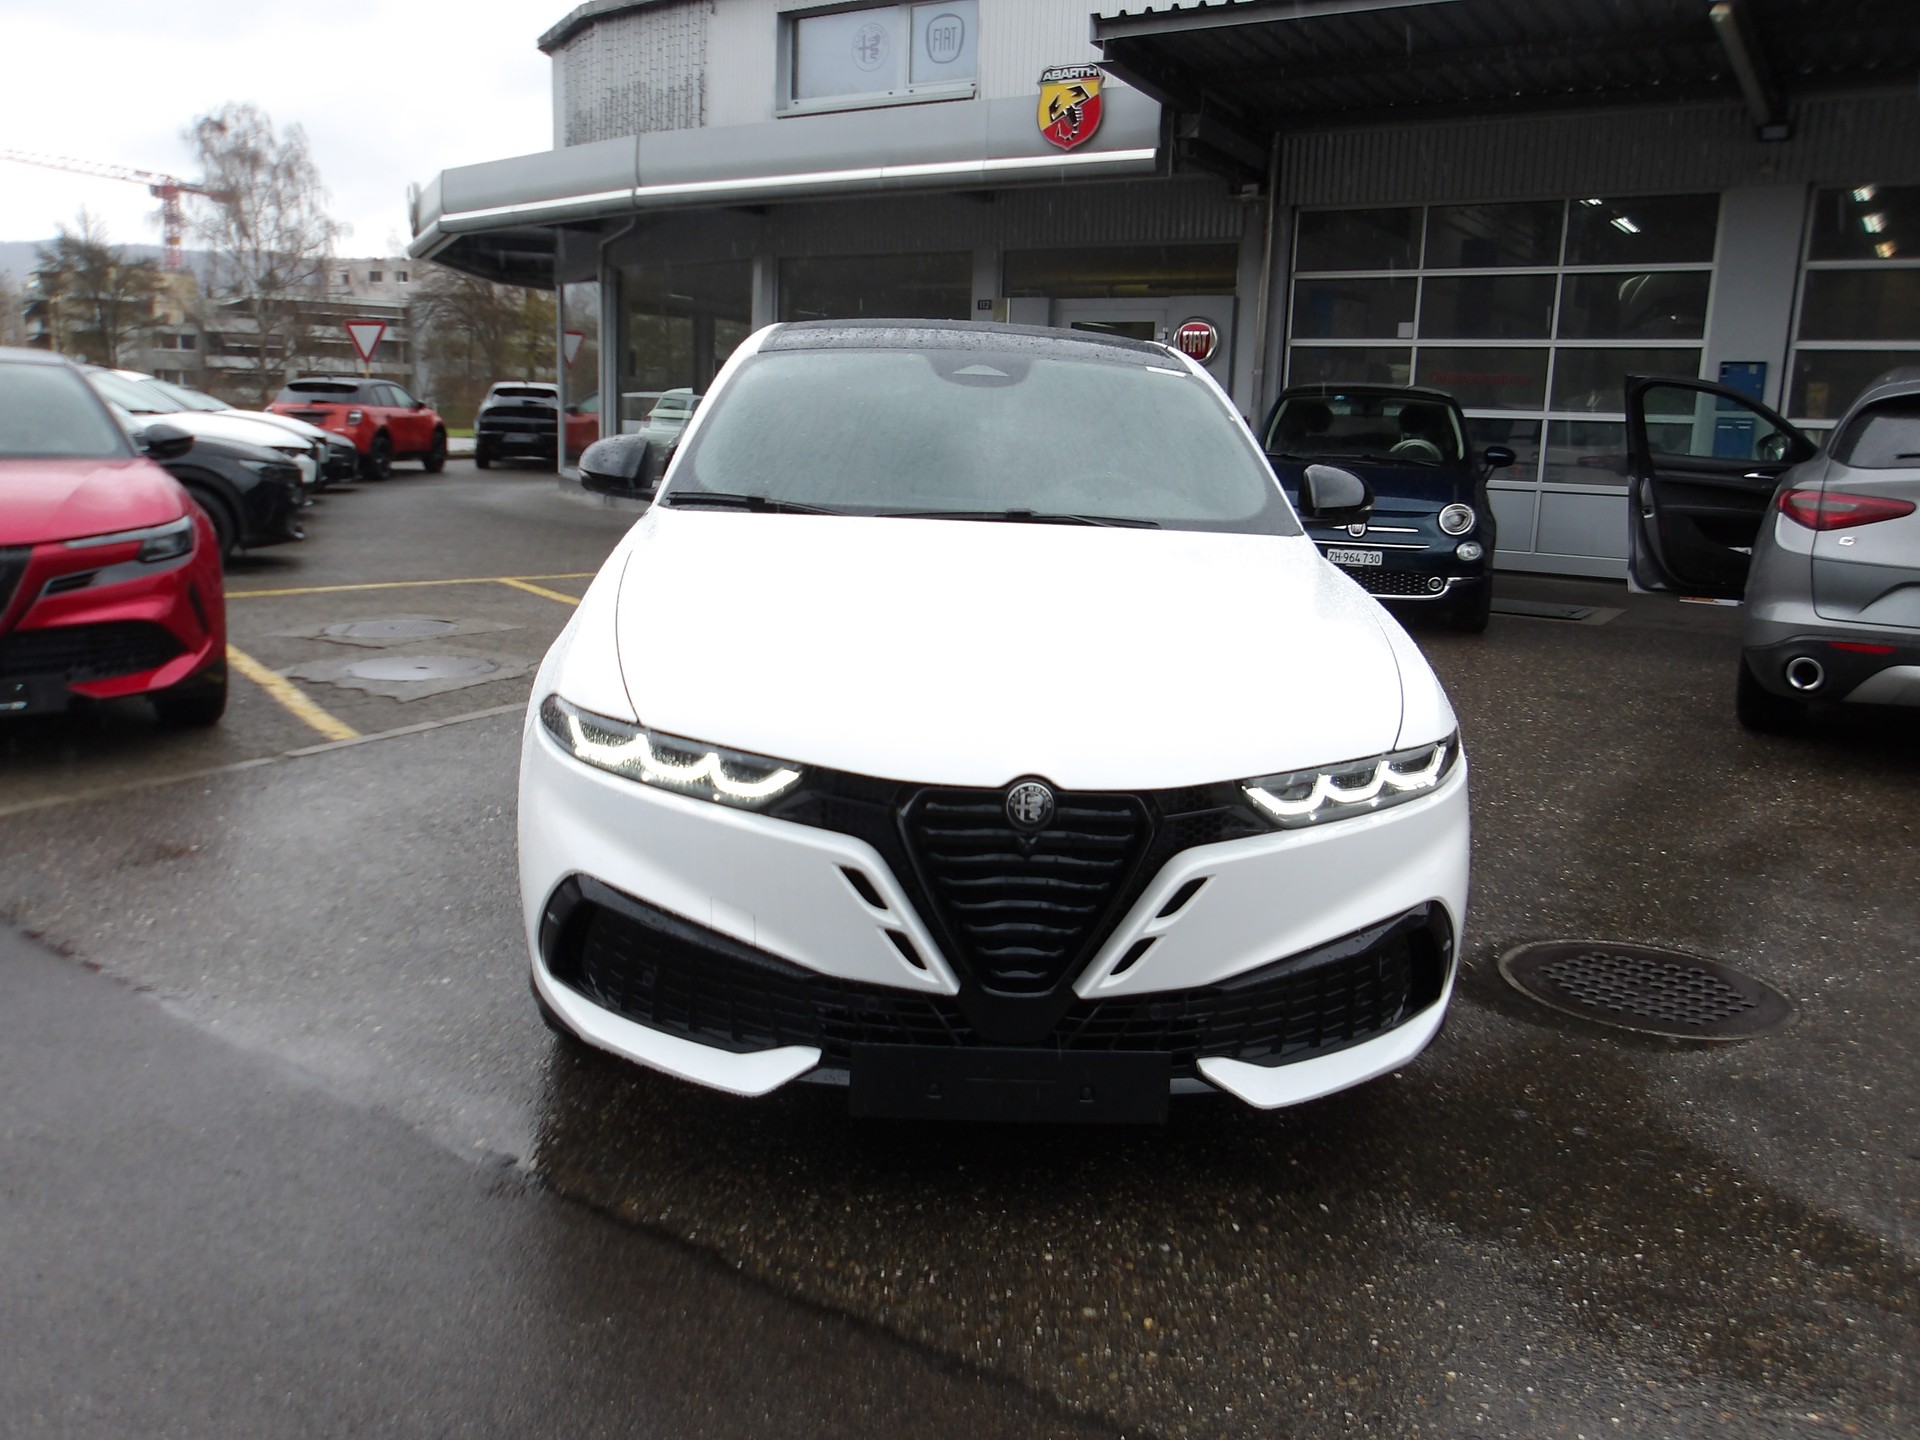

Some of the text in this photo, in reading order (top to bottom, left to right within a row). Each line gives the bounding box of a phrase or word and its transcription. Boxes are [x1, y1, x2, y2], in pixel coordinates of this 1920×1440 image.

[933, 26, 957, 52] FIAT
[1042, 67, 1097, 81] ABARTH
[979, 300, 990, 309] 112
[1183, 331, 1209, 353] FIAT
[1363, 552, 1381, 564] 730
